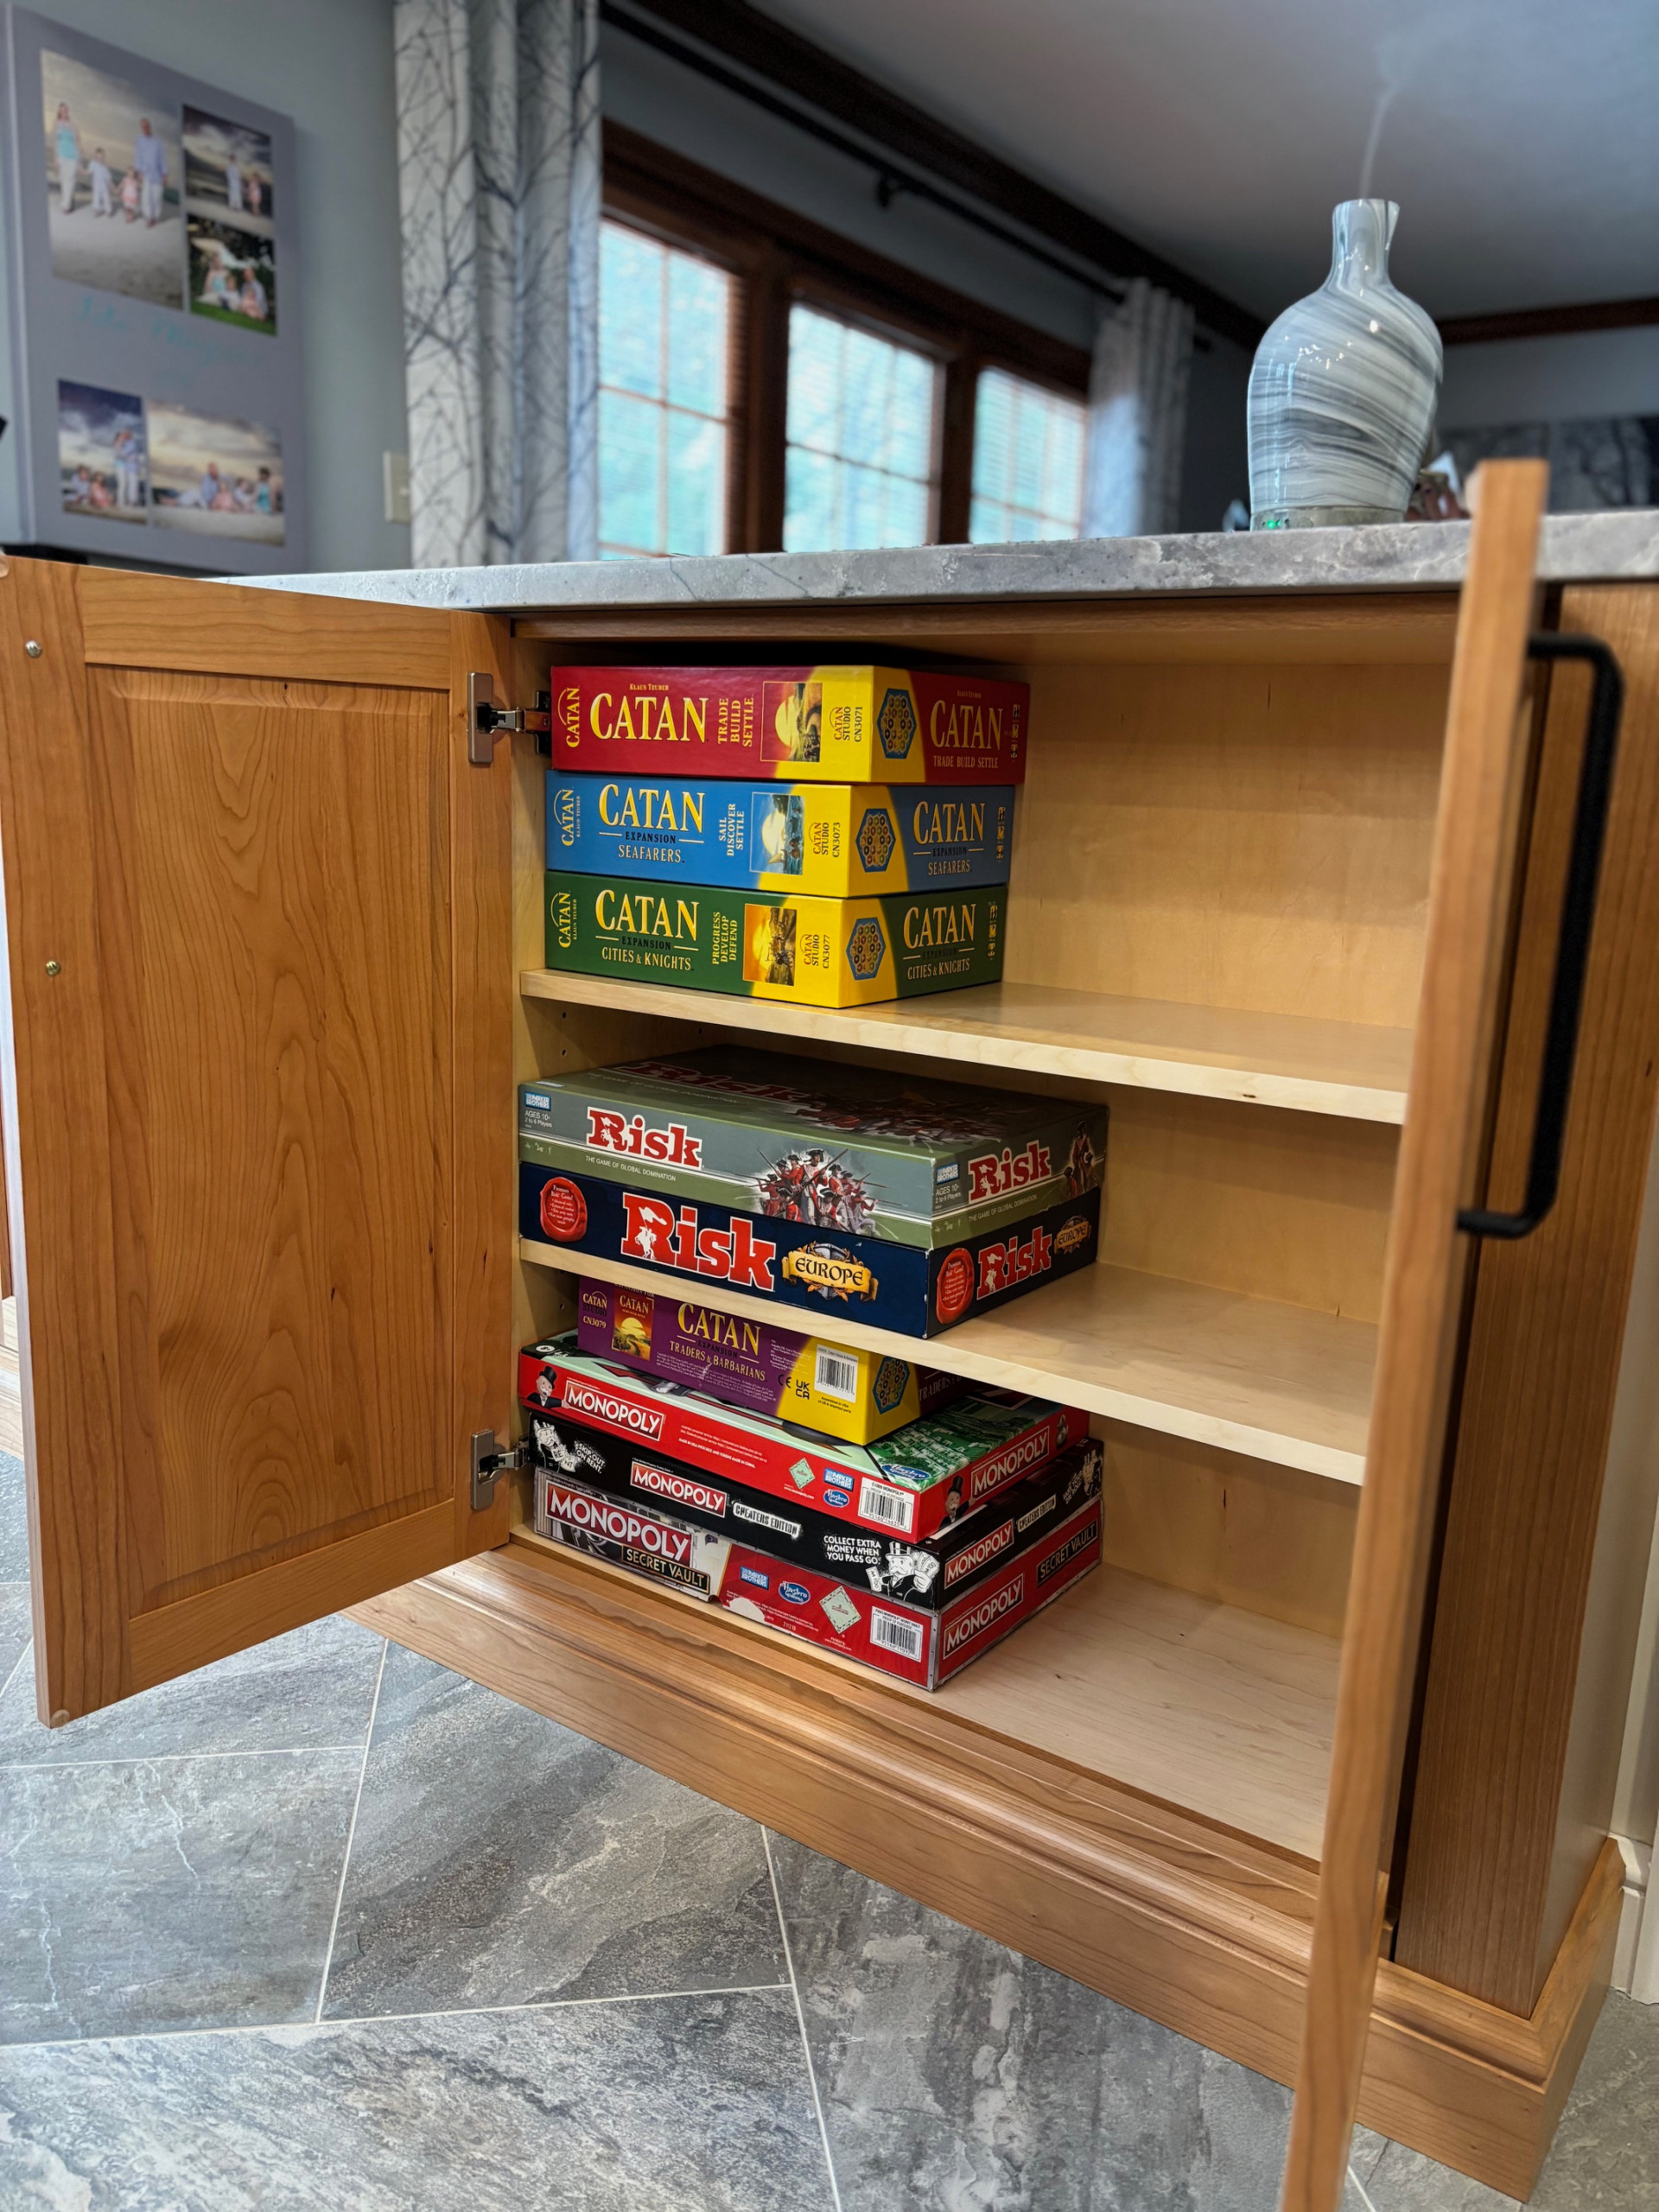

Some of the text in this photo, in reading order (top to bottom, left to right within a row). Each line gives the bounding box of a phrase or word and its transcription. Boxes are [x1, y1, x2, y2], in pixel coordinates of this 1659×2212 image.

[566, 687, 580, 748] CATAN
[589, 693, 709, 743] CATAN
[718, 698, 729, 744] TRADE
[730, 700, 741, 743] BUILD
[743, 697, 753, 747] SETTLE
[834, 707, 843, 741] CATAN
[843, 707, 852, 741] STUDIO
[854, 707, 862, 743] CN3071
[930, 700, 1003, 751] CATAN
[933, 755, 999, 769] TRADE BUILD SETTLE
[562, 789, 574, 847] CATAN
[598, 783, 705, 834] CATAN
[913, 800, 985, 845] CATAN
[626, 831, 676, 844] EXPANSION
[727, 804, 736, 857] DISCOVER
[736, 810, 745, 850] SETTLE
[812, 823, 822, 855] CATAN
[821, 823, 830, 855] STUDIO
[832, 822, 841, 857] CN3073
[619, 845, 681, 863] SEAFARERS
[928, 859, 971, 876] SEAFARERS
[933, 847, 968, 857] EXPANSION
[558, 892, 570, 948] CATAN
[595, 889, 700, 942] CATAN
[904, 904, 976, 950] CATAN
[622, 937, 672, 950] EXPANSION
[712, 911, 721, 964] PROGRESS
[721, 916, 729, 963] DEVELOP
[729, 919, 738, 961] DEFEND
[804, 934, 812, 965] CATAN
[601, 947, 691, 971] CITIES & KNIGHTS
[907, 957, 970, 980] CITIES & KNIGHTS
[923, 949, 958, 960] EXPANSION
[525, 1109, 541, 1118] AGES
[586, 1106, 702, 1171] Risk
[596, 1158, 611, 1167] GAME
[620, 1163, 641, 1173] GLOBAL
[643, 1168, 677, 1182] DOMINATION
[968, 1140, 1052, 1205] Risk
[935, 1185, 950, 1198] AGES
[947, 1192, 961, 1201] Players
[977, 1209, 990, 1220] GAME
[997, 1203, 1014, 1213] GLOBAL
[1014, 1194, 1038, 1208] DOMINATION
[620, 1191, 776, 1293] Risk
[1058, 1224, 1087, 1245] EUROPE
[795, 1256, 863, 1286] EUROPE
[976, 1225, 1052, 1300] Risk
[582, 1293, 607, 1310] CATAN
[582, 1303, 607, 1317] STUDIO
[620, 1294, 649, 1314] CATAN
[583, 1315, 607, 1329] CN3079
[677, 1303, 760, 1357] CATAN
[669, 1340, 705, 1362] TRADERS
[706, 1355, 712, 1363] &
[714, 1357, 766, 1381] BARBARIANS
[698, 1340, 738, 1358] EXPANSION
[795, 1388, 810, 1400] CA
[796, 1379, 810, 1391] UK
[918, 1376, 950, 1402] TRADERS
[569, 1389, 660, 1433] MONOPOLY
[576, 1450, 602, 1474] ON RENT.
[579, 1443, 606, 1466] SKIP OUT
[974, 1433, 1048, 1495] MONOPOLY
[634, 1467, 724, 1511] MONOPOLY
[825, 1476, 852, 1490] BROTHERS
[833, 1472, 852, 1483] PARKER
[826, 1490, 847, 1503] Hasbro
[550, 1488, 688, 1561] MONOPOLY
[736, 1503, 798, 1535] CHEATERS EDITION
[823, 1535, 881, 1548] COLLECT EXTRA
[826, 1544, 880, 1557] MONEY WHEN
[947, 1524, 1011, 1583] MONOPOLY
[1039, 1524, 1096, 1579] SECRET VAULT
[626, 1548, 705, 1587] SECRET VAULT
[748, 1569, 768, 1580] PARKER
[826, 1552, 880, 1566] YOU PASS GO.
[741, 1573, 768, 1588] BROTHERS
[780, 1580, 809, 1599] Hasbro
[946, 1580, 1021, 1652] MONOPOLY
